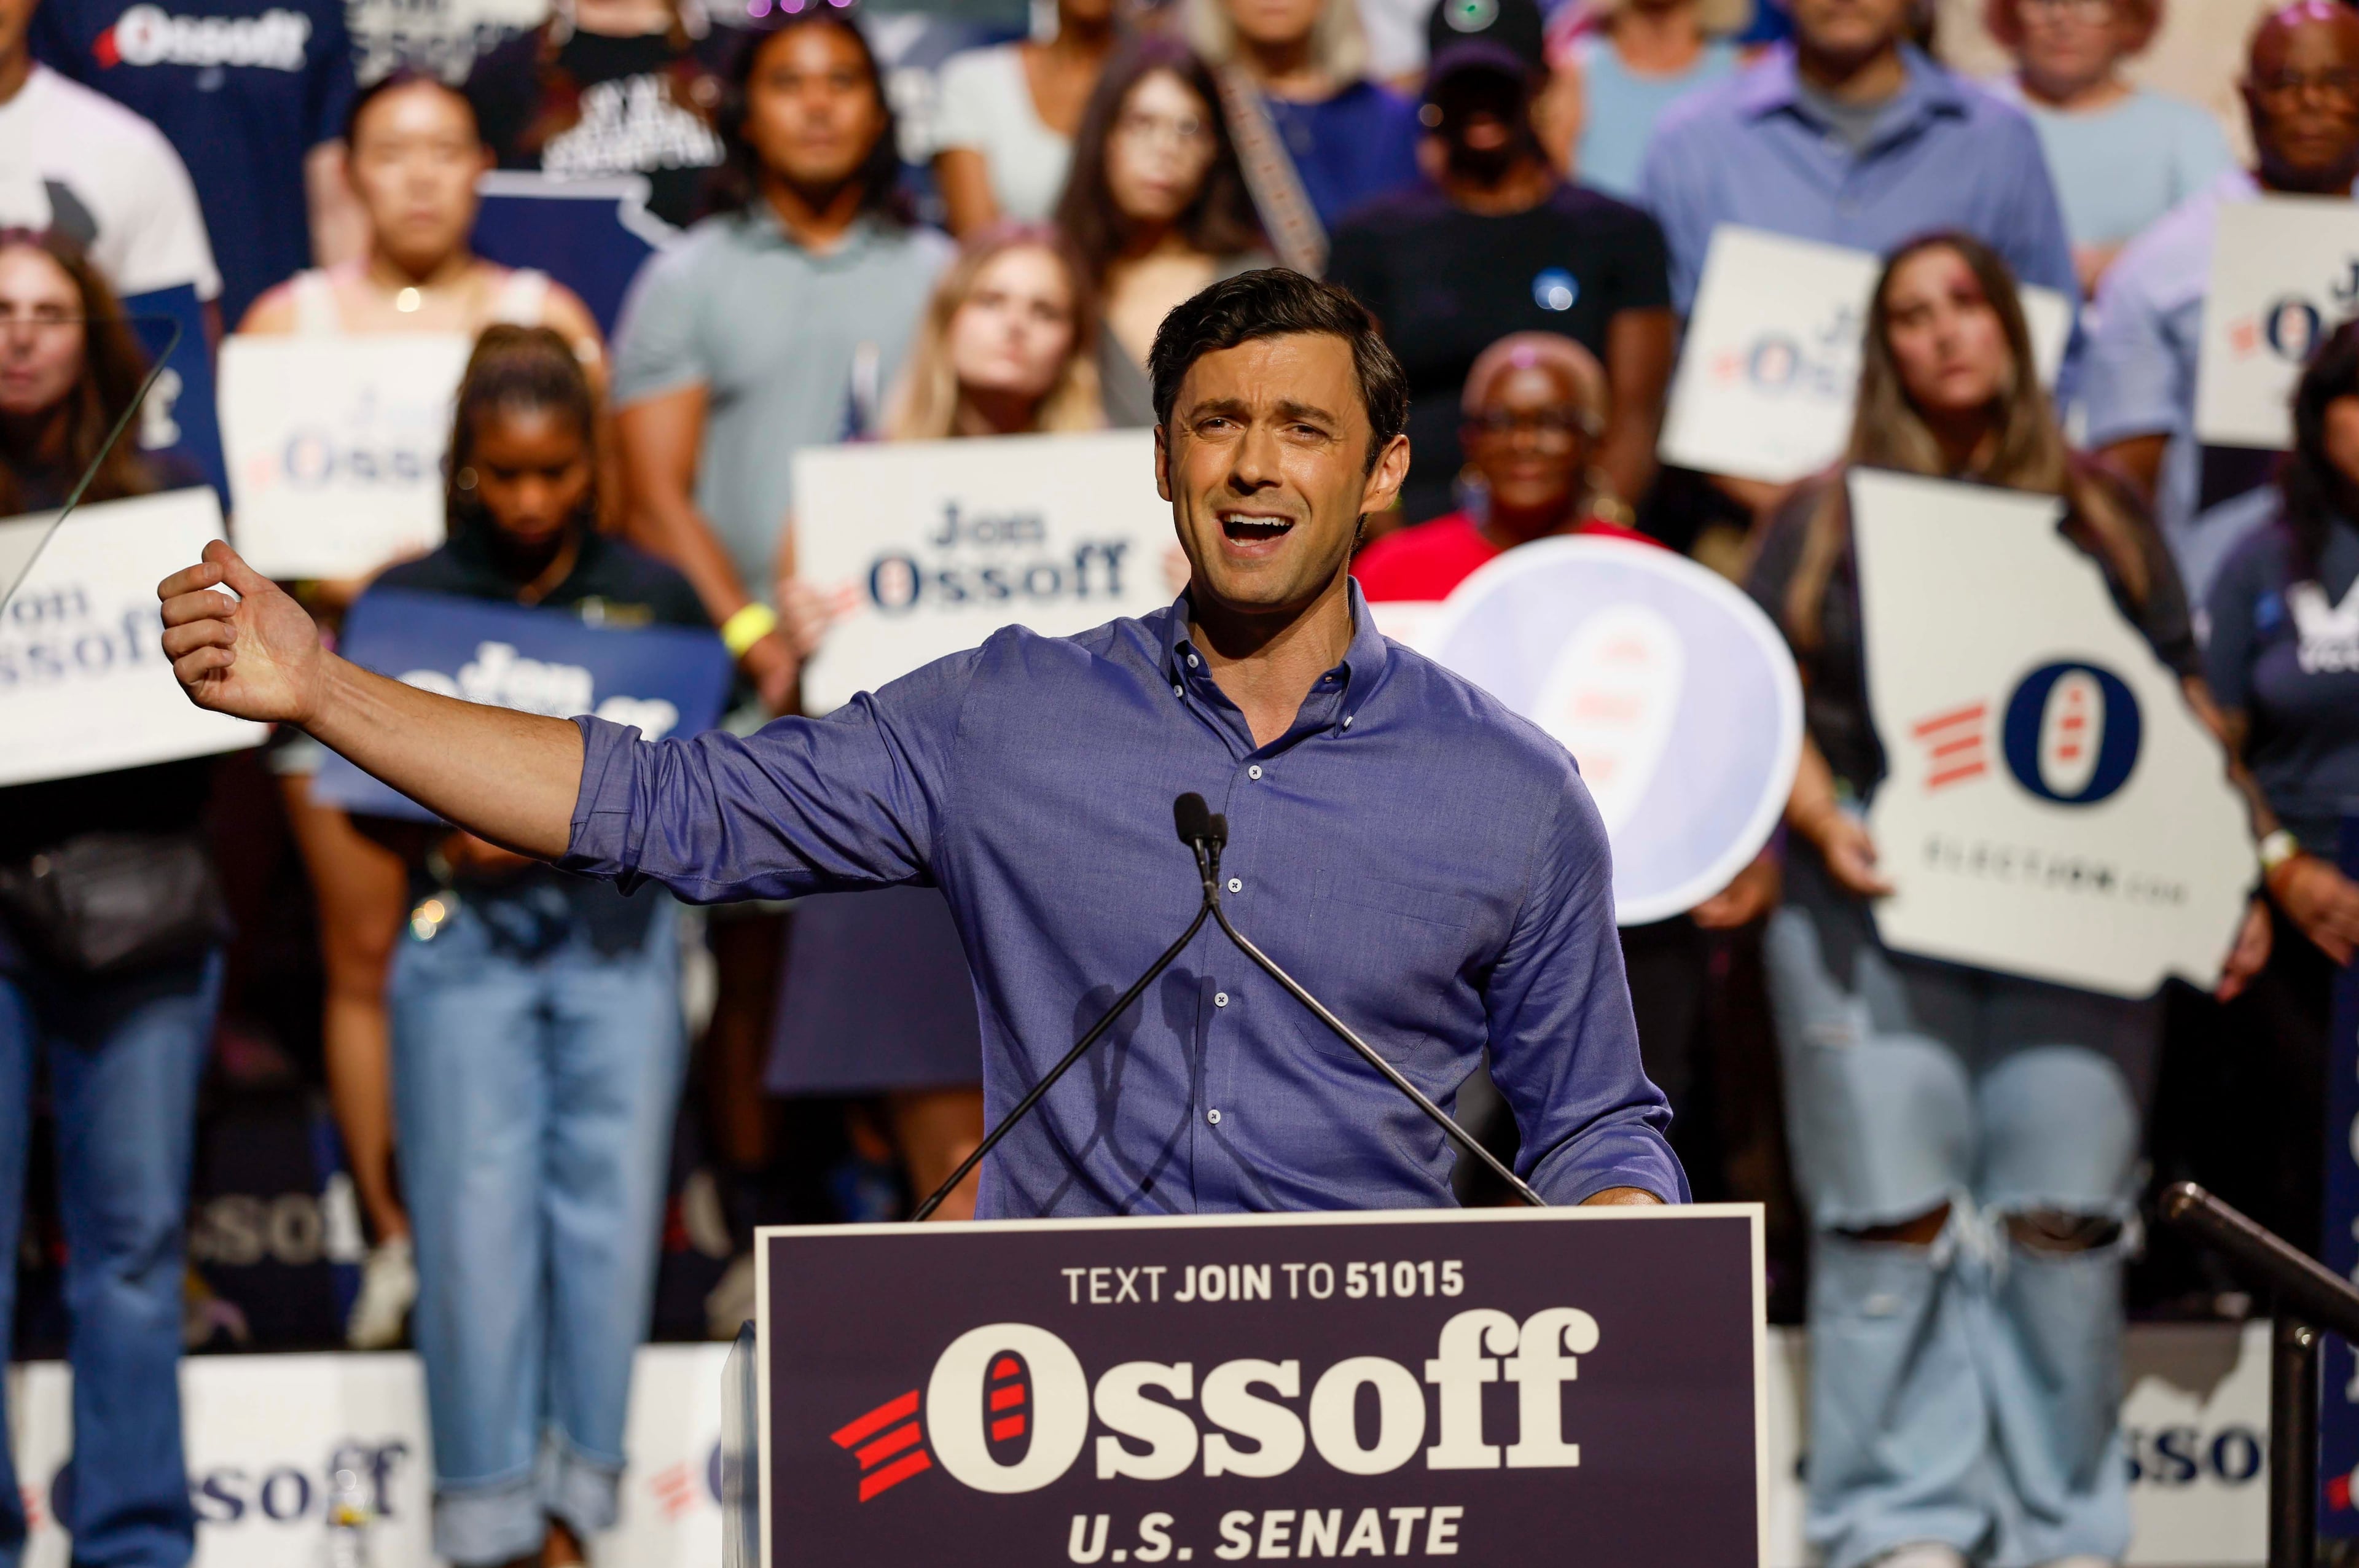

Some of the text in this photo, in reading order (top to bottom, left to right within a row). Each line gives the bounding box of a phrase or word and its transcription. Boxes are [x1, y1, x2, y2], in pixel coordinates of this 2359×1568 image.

[926, 499, 1047, 550] Jon
[864, 534, 1133, 615] Ossoff
[1062, 1260, 1465, 1305] TEXT JOIN TO 51015
[926, 1306, 1600, 1494] Ossoff
[1068, 1505, 1465, 1564] U.S. SENATE
